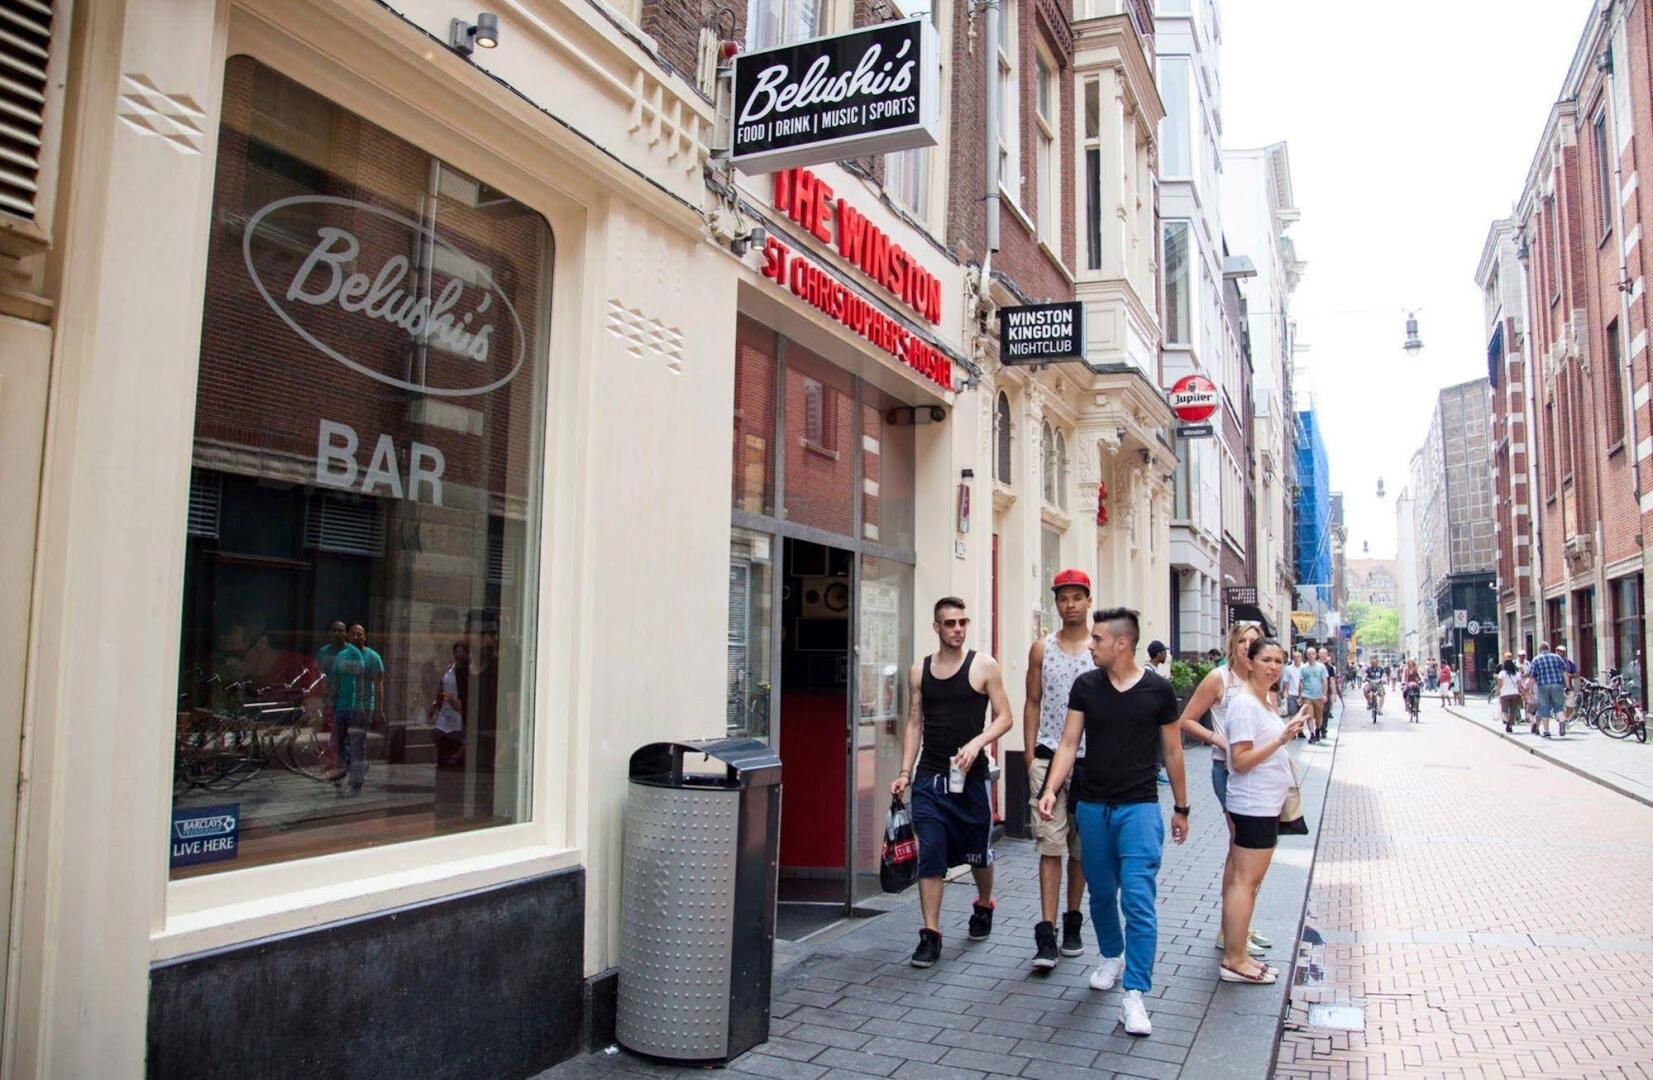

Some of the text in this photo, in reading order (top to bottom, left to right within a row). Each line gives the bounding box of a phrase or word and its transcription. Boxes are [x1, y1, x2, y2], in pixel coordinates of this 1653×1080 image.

[738, 39, 916, 126] Belushi's
[737, 95, 915, 144] FOOD DRINK MUSIC SPORTS
[761, 235, 790, 286] ST
[774, 166, 941, 326] THE WINSTON
[286, 226, 494, 363] Belushi's
[1008, 309, 1073, 326] WINSTON
[1008, 323, 1073, 340] KINGDOM
[1009, 339, 1072, 355] NIGHTCLUB
[1174, 392, 1213, 405] Jupiler
[316, 418, 446, 507] BAR
[183, 818, 223, 831] BARCLAYS
[173, 836, 235, 857] LIVE HERE
